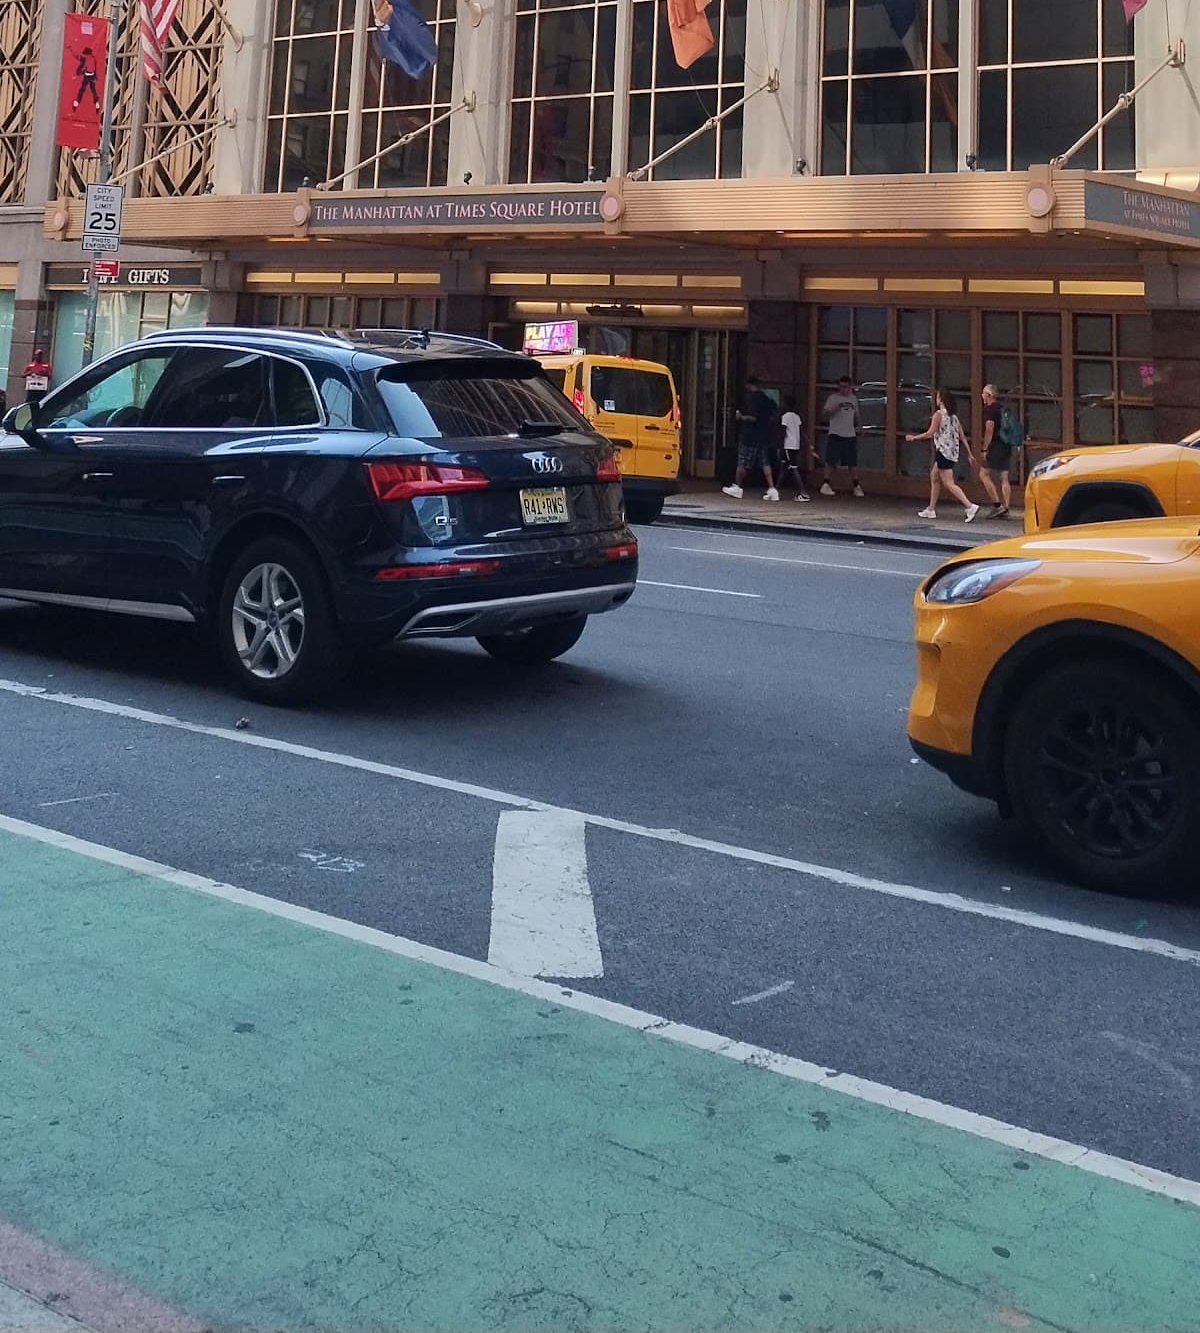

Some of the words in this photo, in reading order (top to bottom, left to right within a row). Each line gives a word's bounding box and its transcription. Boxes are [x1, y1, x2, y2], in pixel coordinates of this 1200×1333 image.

[315, 206, 338, 220] THE
[342, 205, 423, 219] MANHATTAN
[426, 205, 442, 218] AT
[445, 202, 486, 218] TIMES
[489, 201, 545, 220] SQUARE
[550, 200, 600, 216] HOTEL
[1123, 191, 1138, 208] THE
[1141, 193, 1190, 217] MANHATTAN
[89, 212, 117, 231] 25
[85, 242, 116, 250] ENFORCED
[127, 269, 170, 285] GIFTS
